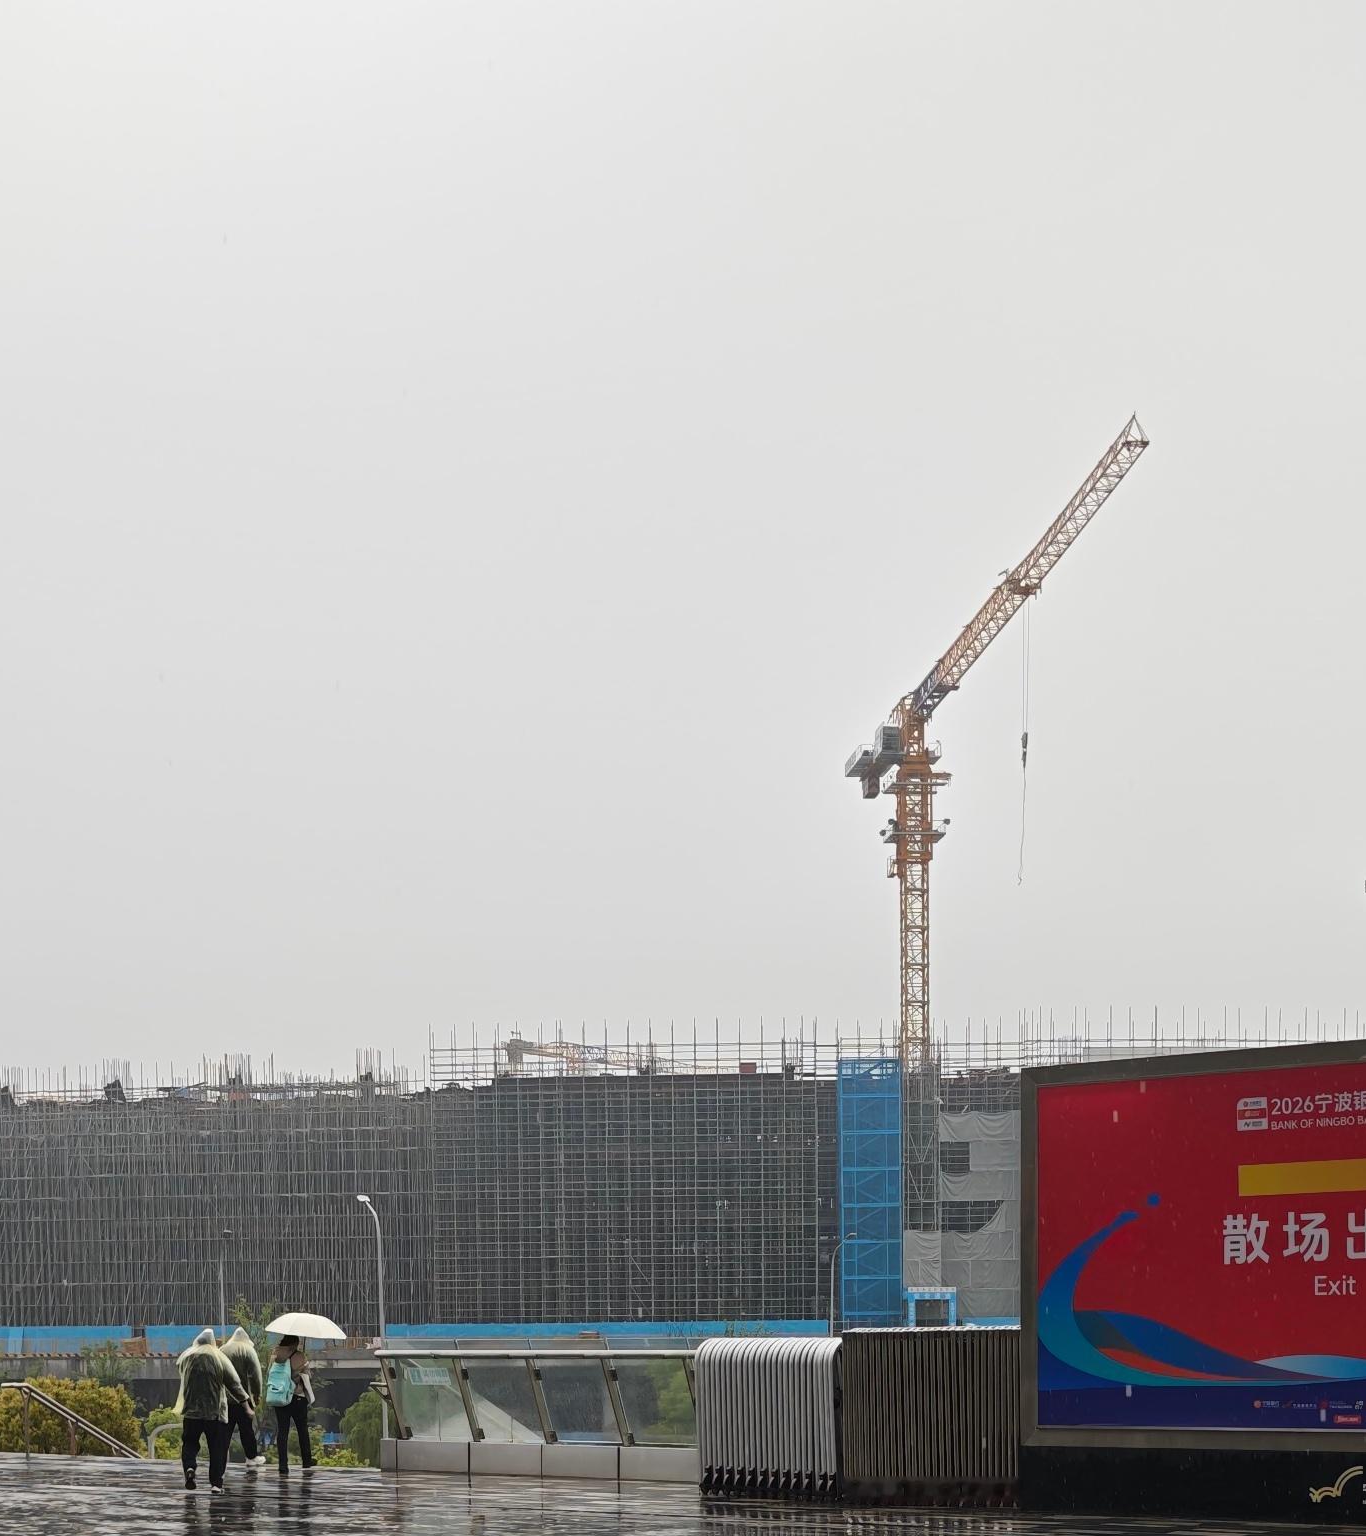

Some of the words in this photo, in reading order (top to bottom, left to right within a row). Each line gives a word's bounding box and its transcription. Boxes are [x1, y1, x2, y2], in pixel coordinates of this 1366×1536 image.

[1270, 1119, 1298, 1130] BANK
[1300, 1118, 1315, 1129] OF
[1316, 1115, 1355, 1127] NINGBO
[1314, 1274, 1357, 1296] Exit
